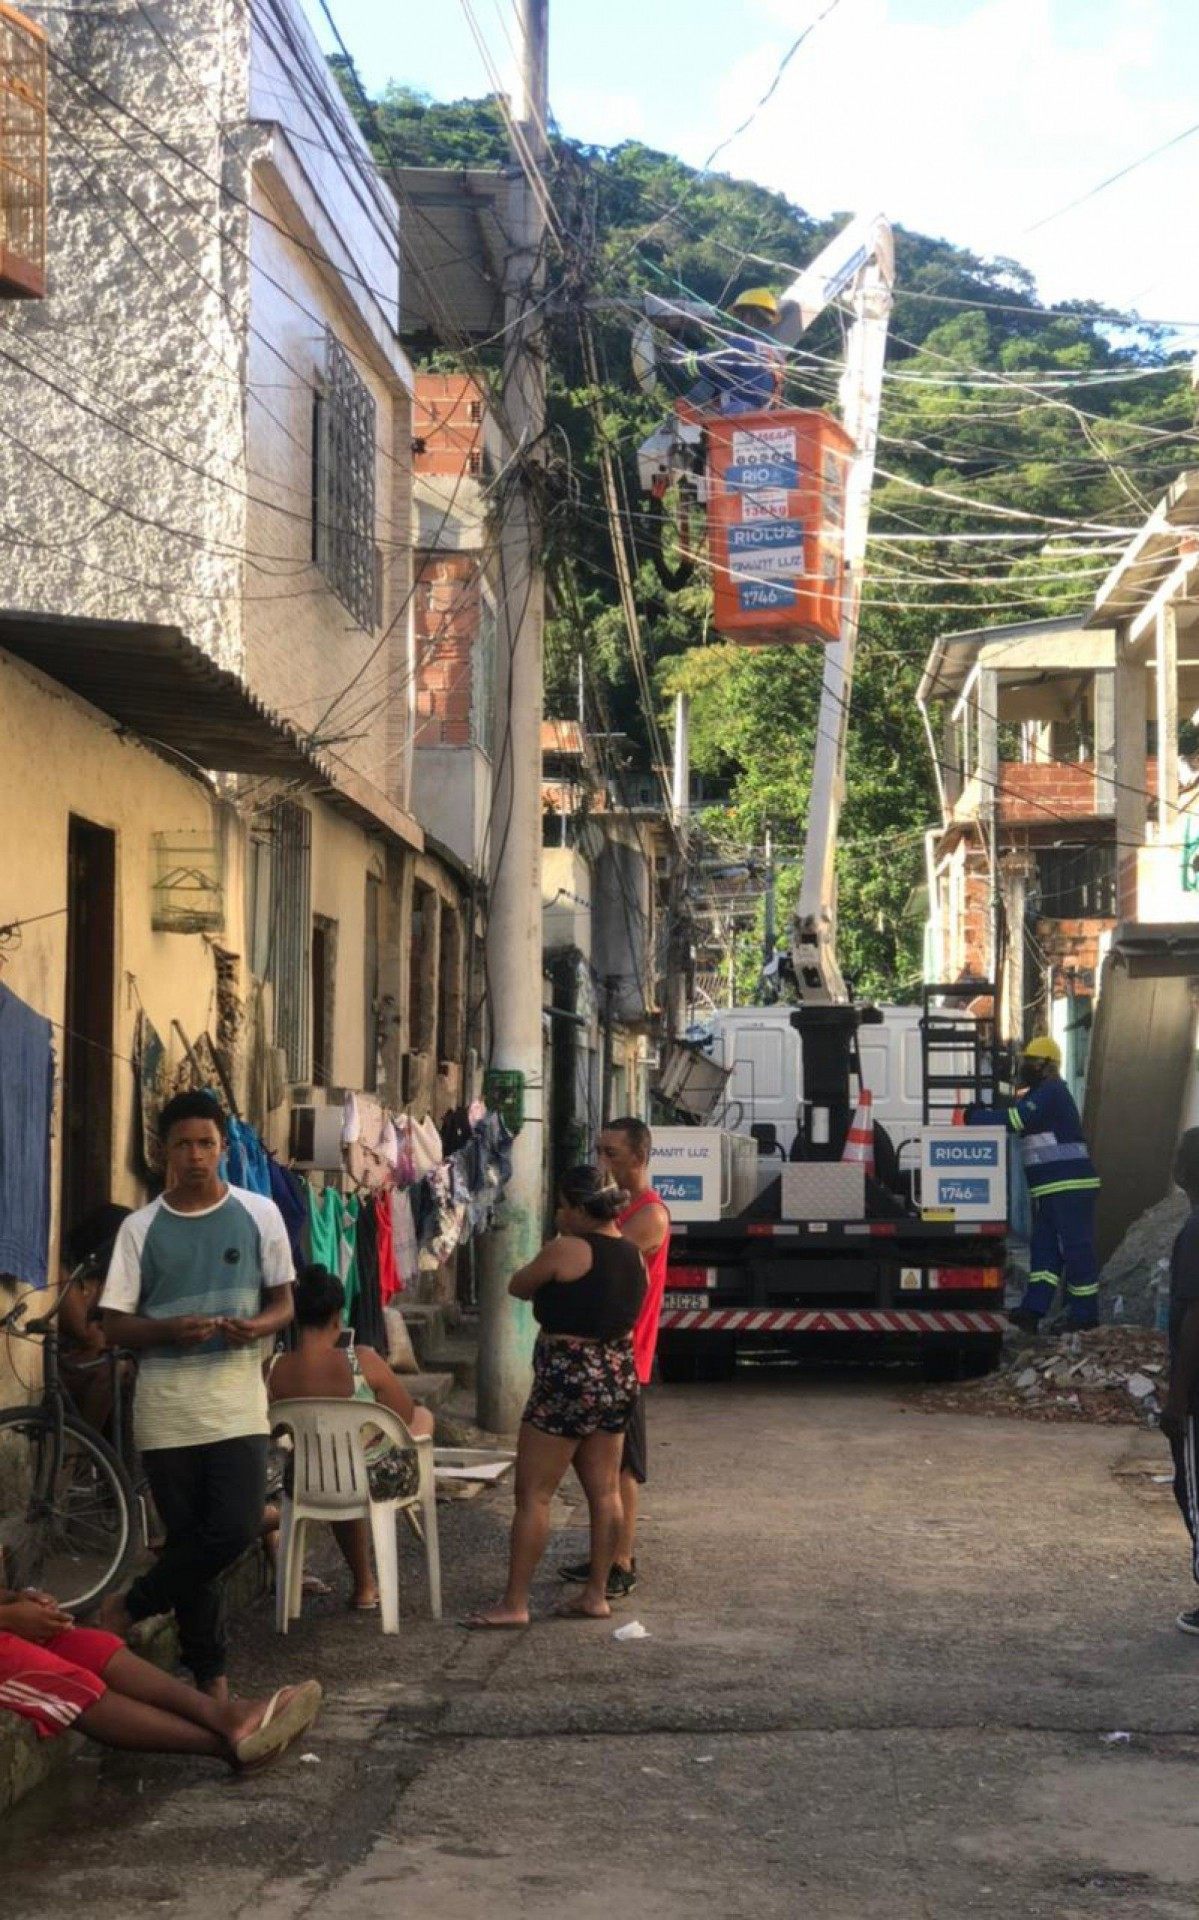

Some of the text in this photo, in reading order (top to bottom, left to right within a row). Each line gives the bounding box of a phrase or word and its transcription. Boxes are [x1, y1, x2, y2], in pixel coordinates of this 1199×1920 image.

[742, 468, 770, 484] RIO
[735, 526, 796, 545] RIOLUZ
[778, 555, 801, 567] LUZ
[742, 589, 778, 606] 1746
[687, 1147, 709, 1158] LUZ
[936, 1146, 992, 1160] RIOLUZ
[941, 1186, 973, 1201] 1746
